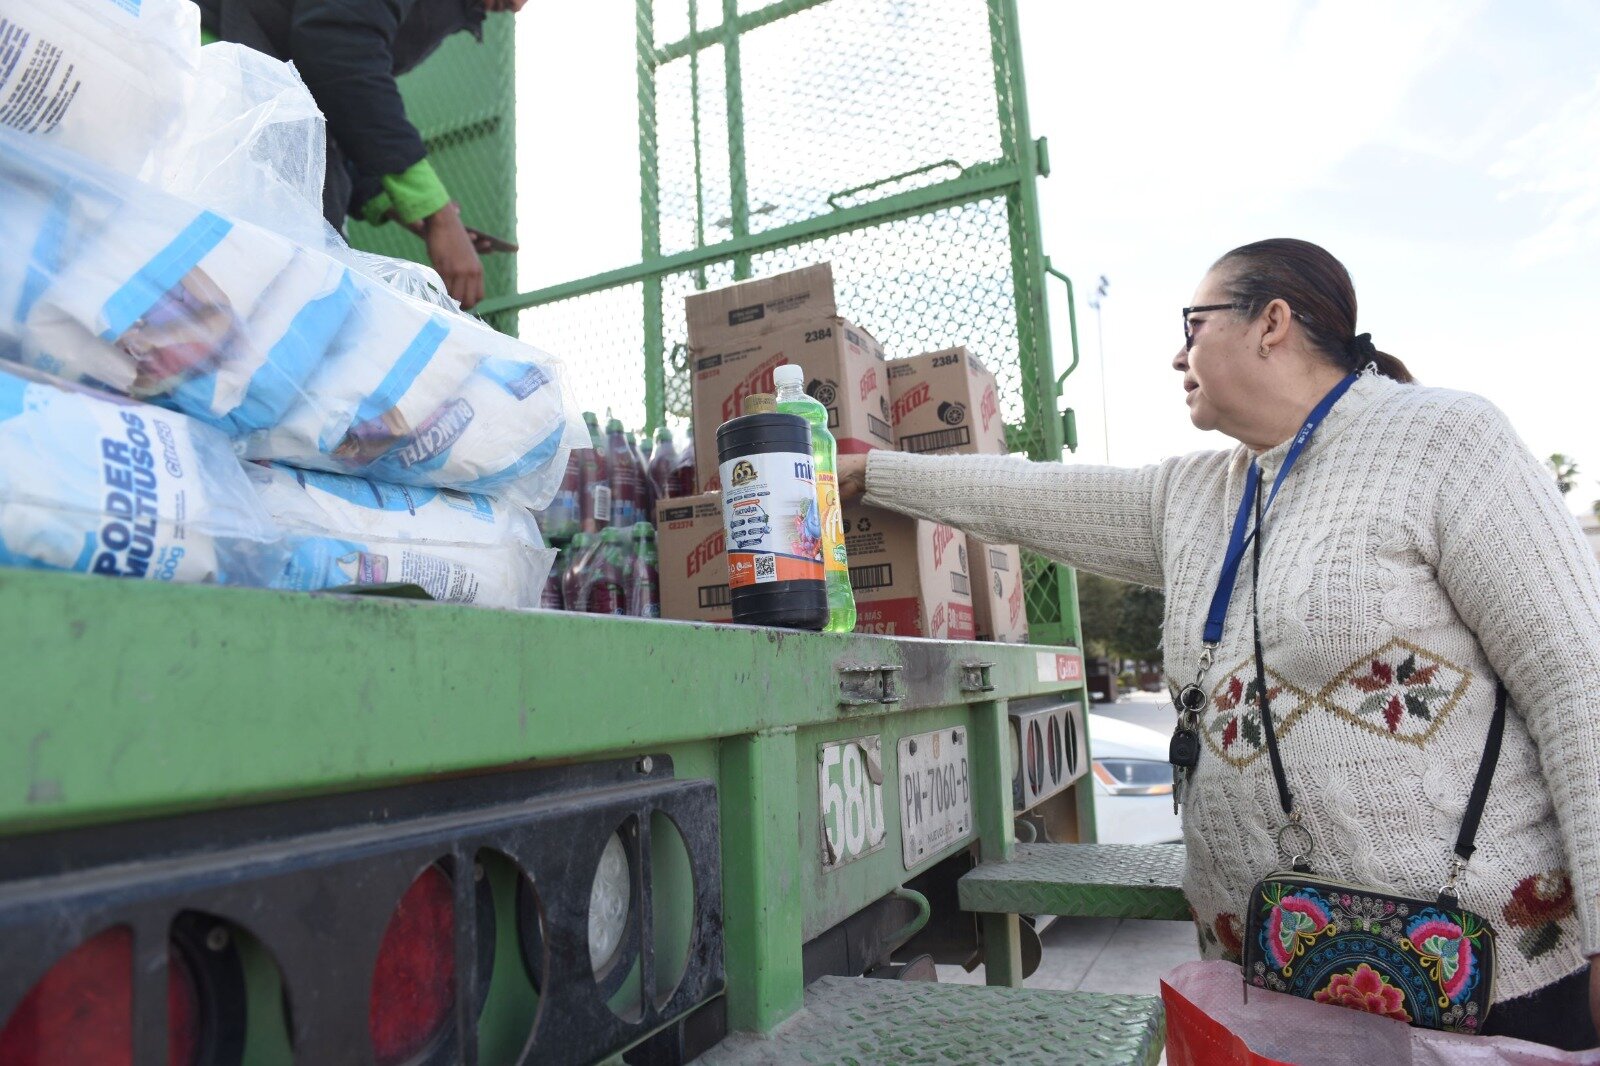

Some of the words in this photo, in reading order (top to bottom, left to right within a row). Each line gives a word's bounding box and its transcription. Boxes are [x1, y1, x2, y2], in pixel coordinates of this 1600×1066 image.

[805, 328, 832, 343] 2384
[932, 354, 959, 368] 2384
[399, 400, 473, 468] BLANCATEL
[734, 461, 754, 480] 65
[794, 460, 813, 480] mi
[819, 474, 836, 482] AROM
[120, 411, 158, 577] MULTIUSOS
[92, 438, 134, 577] PODER
